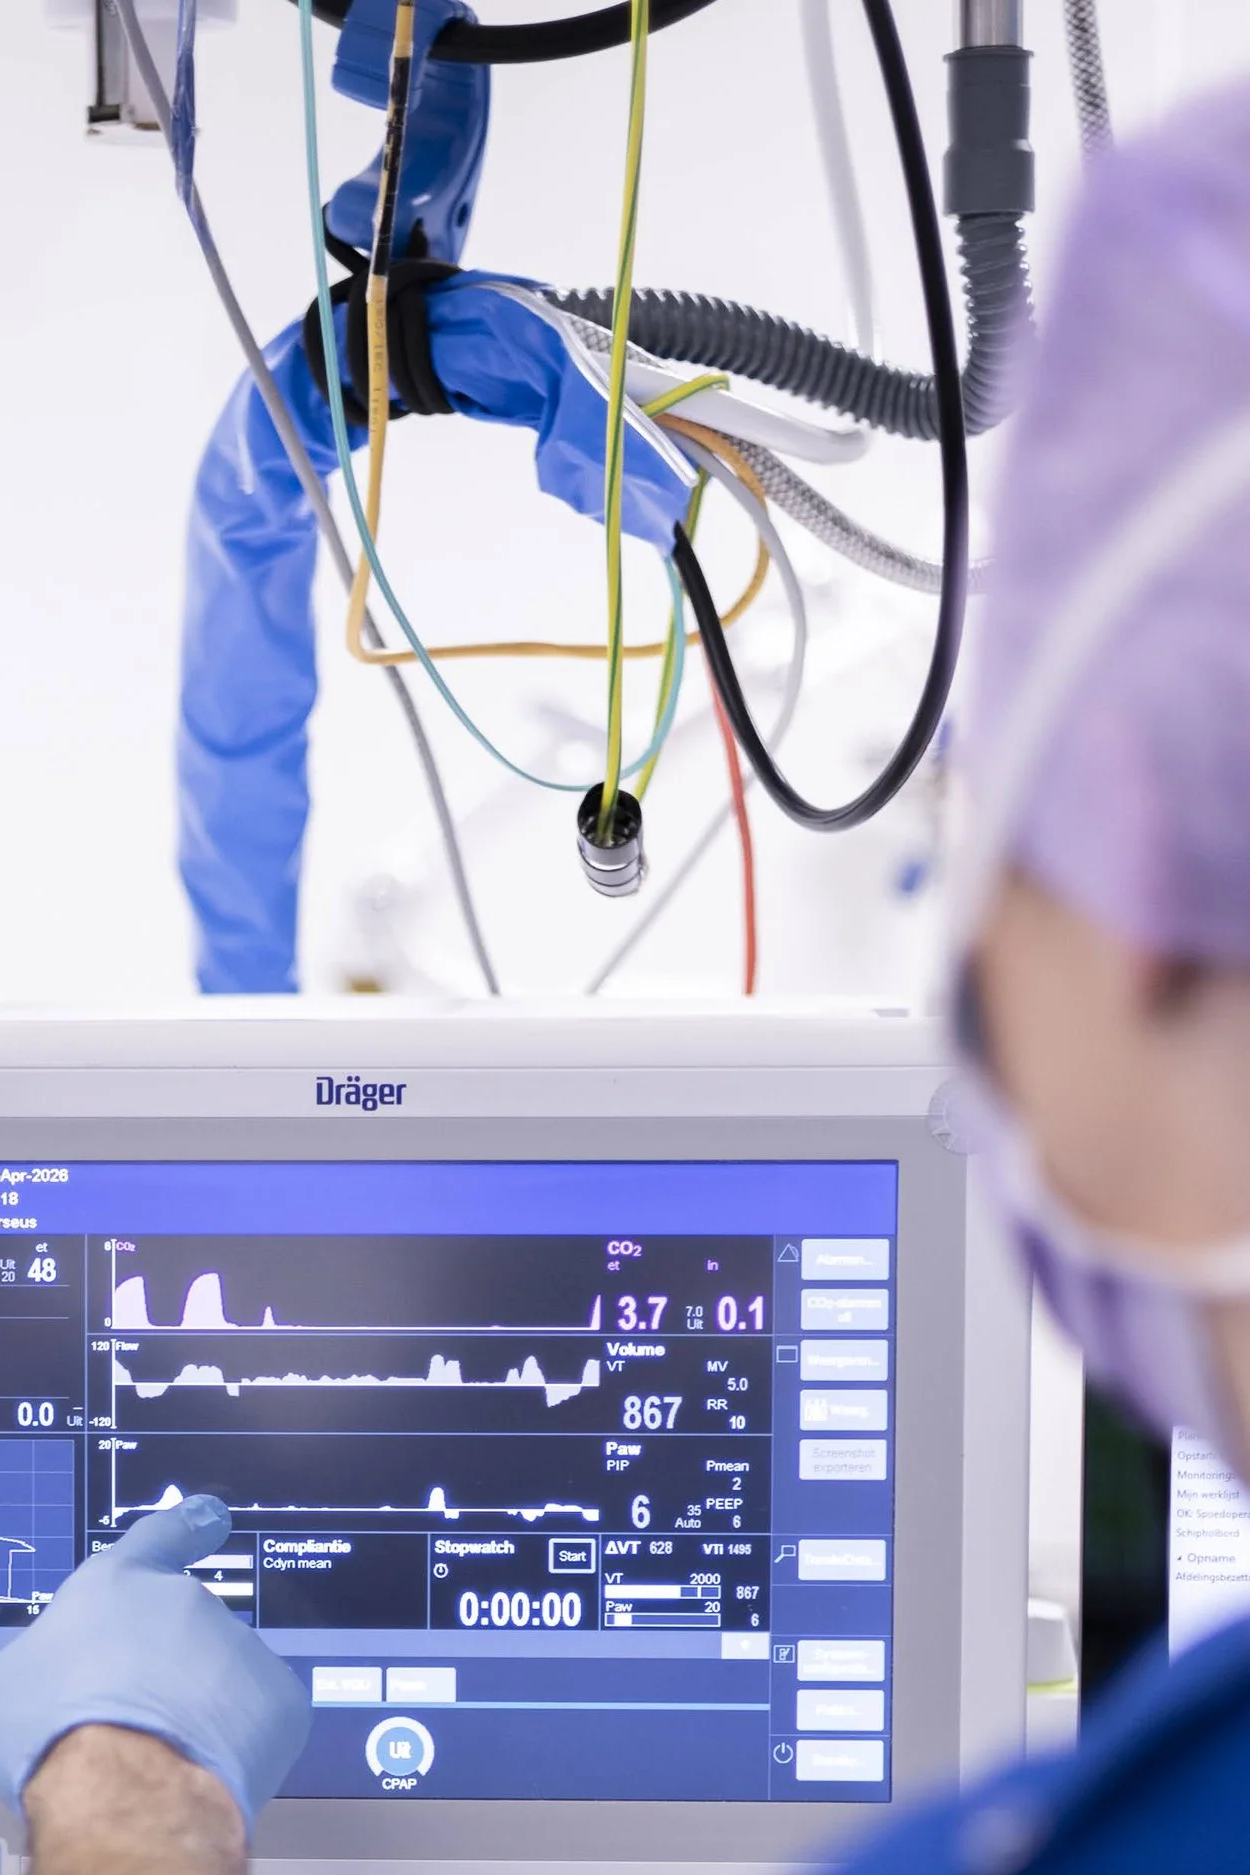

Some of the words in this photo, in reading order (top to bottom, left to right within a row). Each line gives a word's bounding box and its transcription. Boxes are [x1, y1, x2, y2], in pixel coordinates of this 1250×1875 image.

[316, 1075, 407, 1112] Dräger
[35, 1242, 48, 1252] et
[607, 1240, 642, 1257] CO2
[27, 1257, 57, 1282] 48
[607, 1260, 620, 1271] et
[707, 1259, 719, 1271] in
[1, 1272, 16, 1282] 20
[617, 1295, 669, 1330] 3.7
[717, 1295, 764, 1331] 0.1
[91, 1341, 110, 1351] 120
[116, 1341, 139, 1351] Flow
[606, 1342, 666, 1356] Volume
[607, 1360, 626, 1372] VT
[707, 1361, 729, 1372] MV
[727, 1378, 749, 1391] 5.0
[706, 1398, 728, 1410] RR
[17, 1402, 54, 1426] 0.0
[623, 1395, 683, 1430] 867
[729, 1416, 746, 1429] 10
[116, 1440, 138, 1450] Paw
[606, 1442, 641, 1456] Paw
[607, 1460, 630, 1471] PIP
[706, 1460, 750, 1471] Pmean
[732, 1477, 742, 1491] 2
[706, 1498, 743, 1510] PEEP
[631, 1494, 651, 1529] 6
[687, 1505, 702, 1516] 35
[674, 1517, 702, 1529] Auto
[732, 1515, 742, 1529] 6
[263, 1539, 352, 1556] Compliantie
[434, 1540, 515, 1556] Stopwatch
[649, 1541, 673, 1555] 628
[727, 1544, 752, 1555] 1495
[558, 1550, 587, 1562] Start
[263, 1557, 296, 1571] Cdyn
[297, 1561, 332, 1569] mean
[213, 1570, 224, 1582] 4
[605, 1573, 624, 1584] VT
[689, 1573, 721, 1585] 2000
[736, 1586, 759, 1600] 867
[459, 1591, 582, 1626] 0:00:00
[605, 1601, 633, 1612] Paw
[704, 1602, 721, 1613] 20
[751, 1613, 759, 1627] 6
[382, 1778, 417, 1790] CPAP
